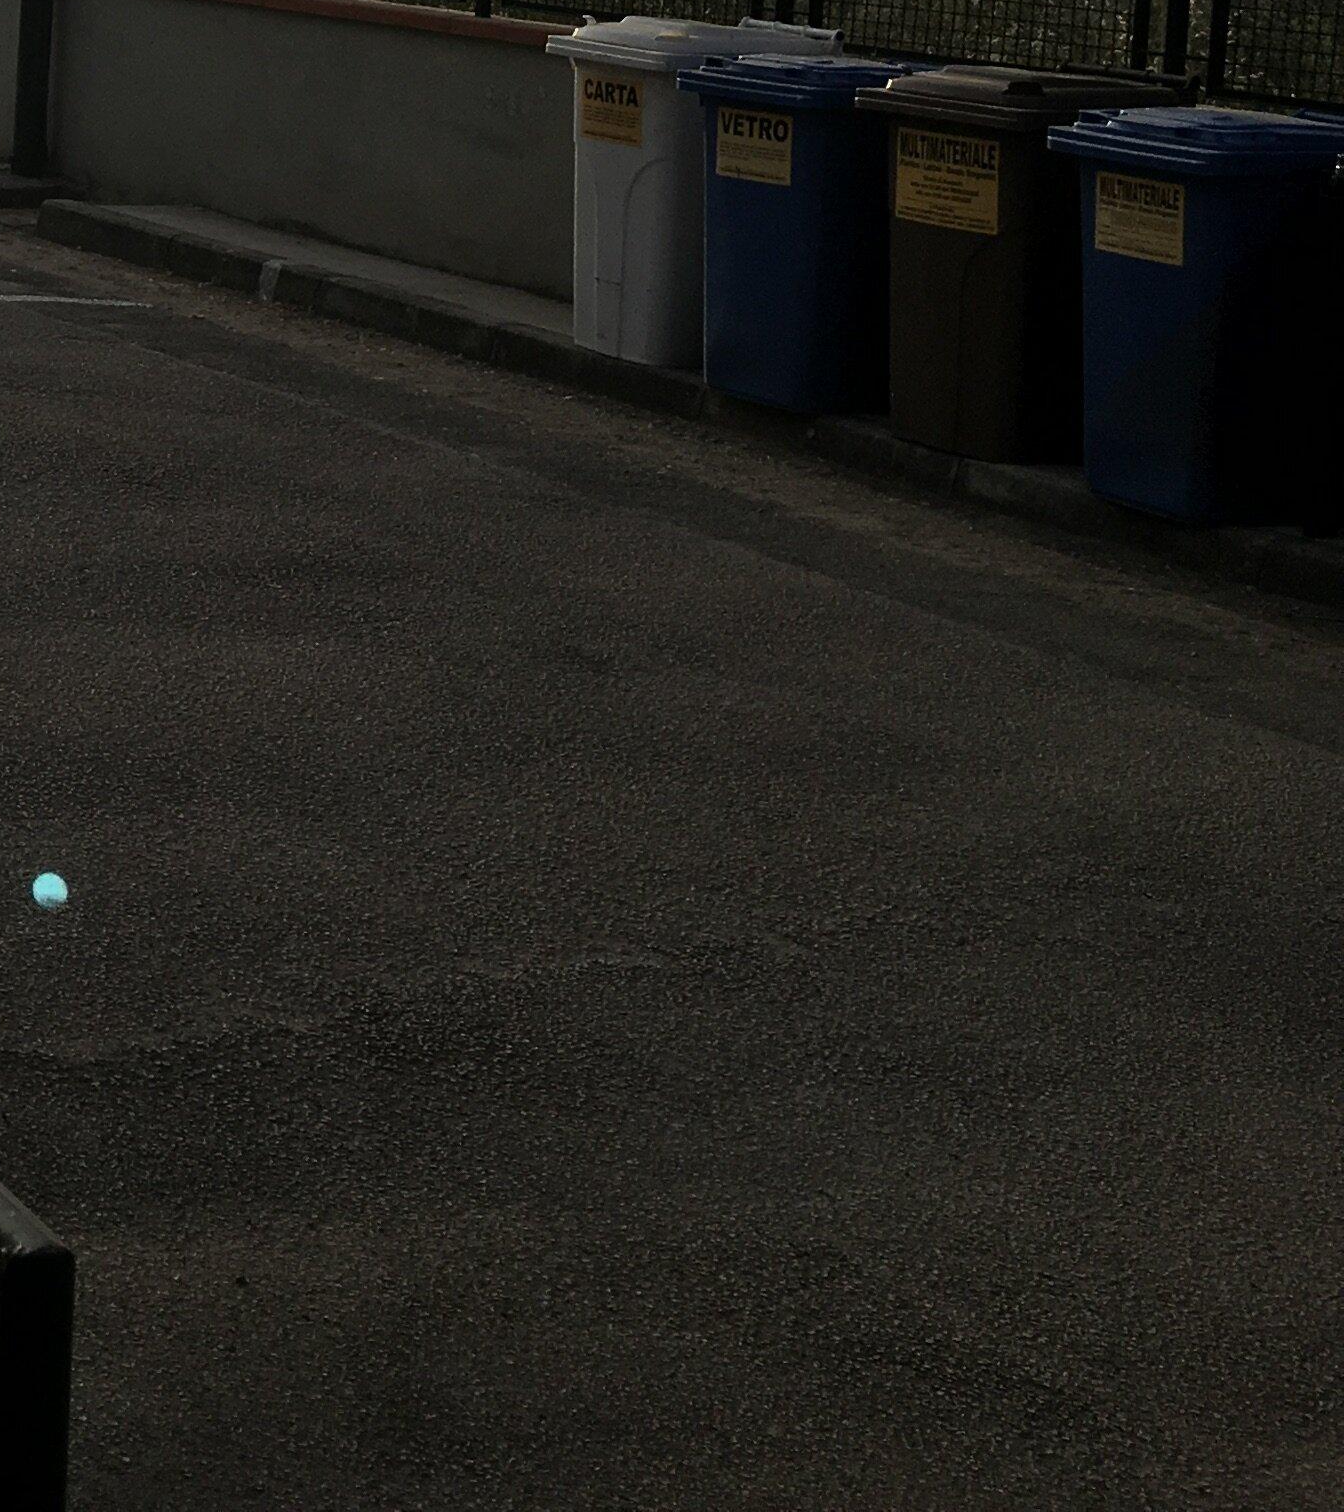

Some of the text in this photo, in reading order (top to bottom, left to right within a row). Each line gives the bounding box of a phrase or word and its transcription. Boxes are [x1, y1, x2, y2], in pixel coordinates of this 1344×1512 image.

[583, 78, 640, 107] CARTA
[721, 111, 789, 143] VETRO
[899, 129, 997, 170] MULTIMATERIALE
[1099, 176, 1180, 211] MULTIMATERIALE
